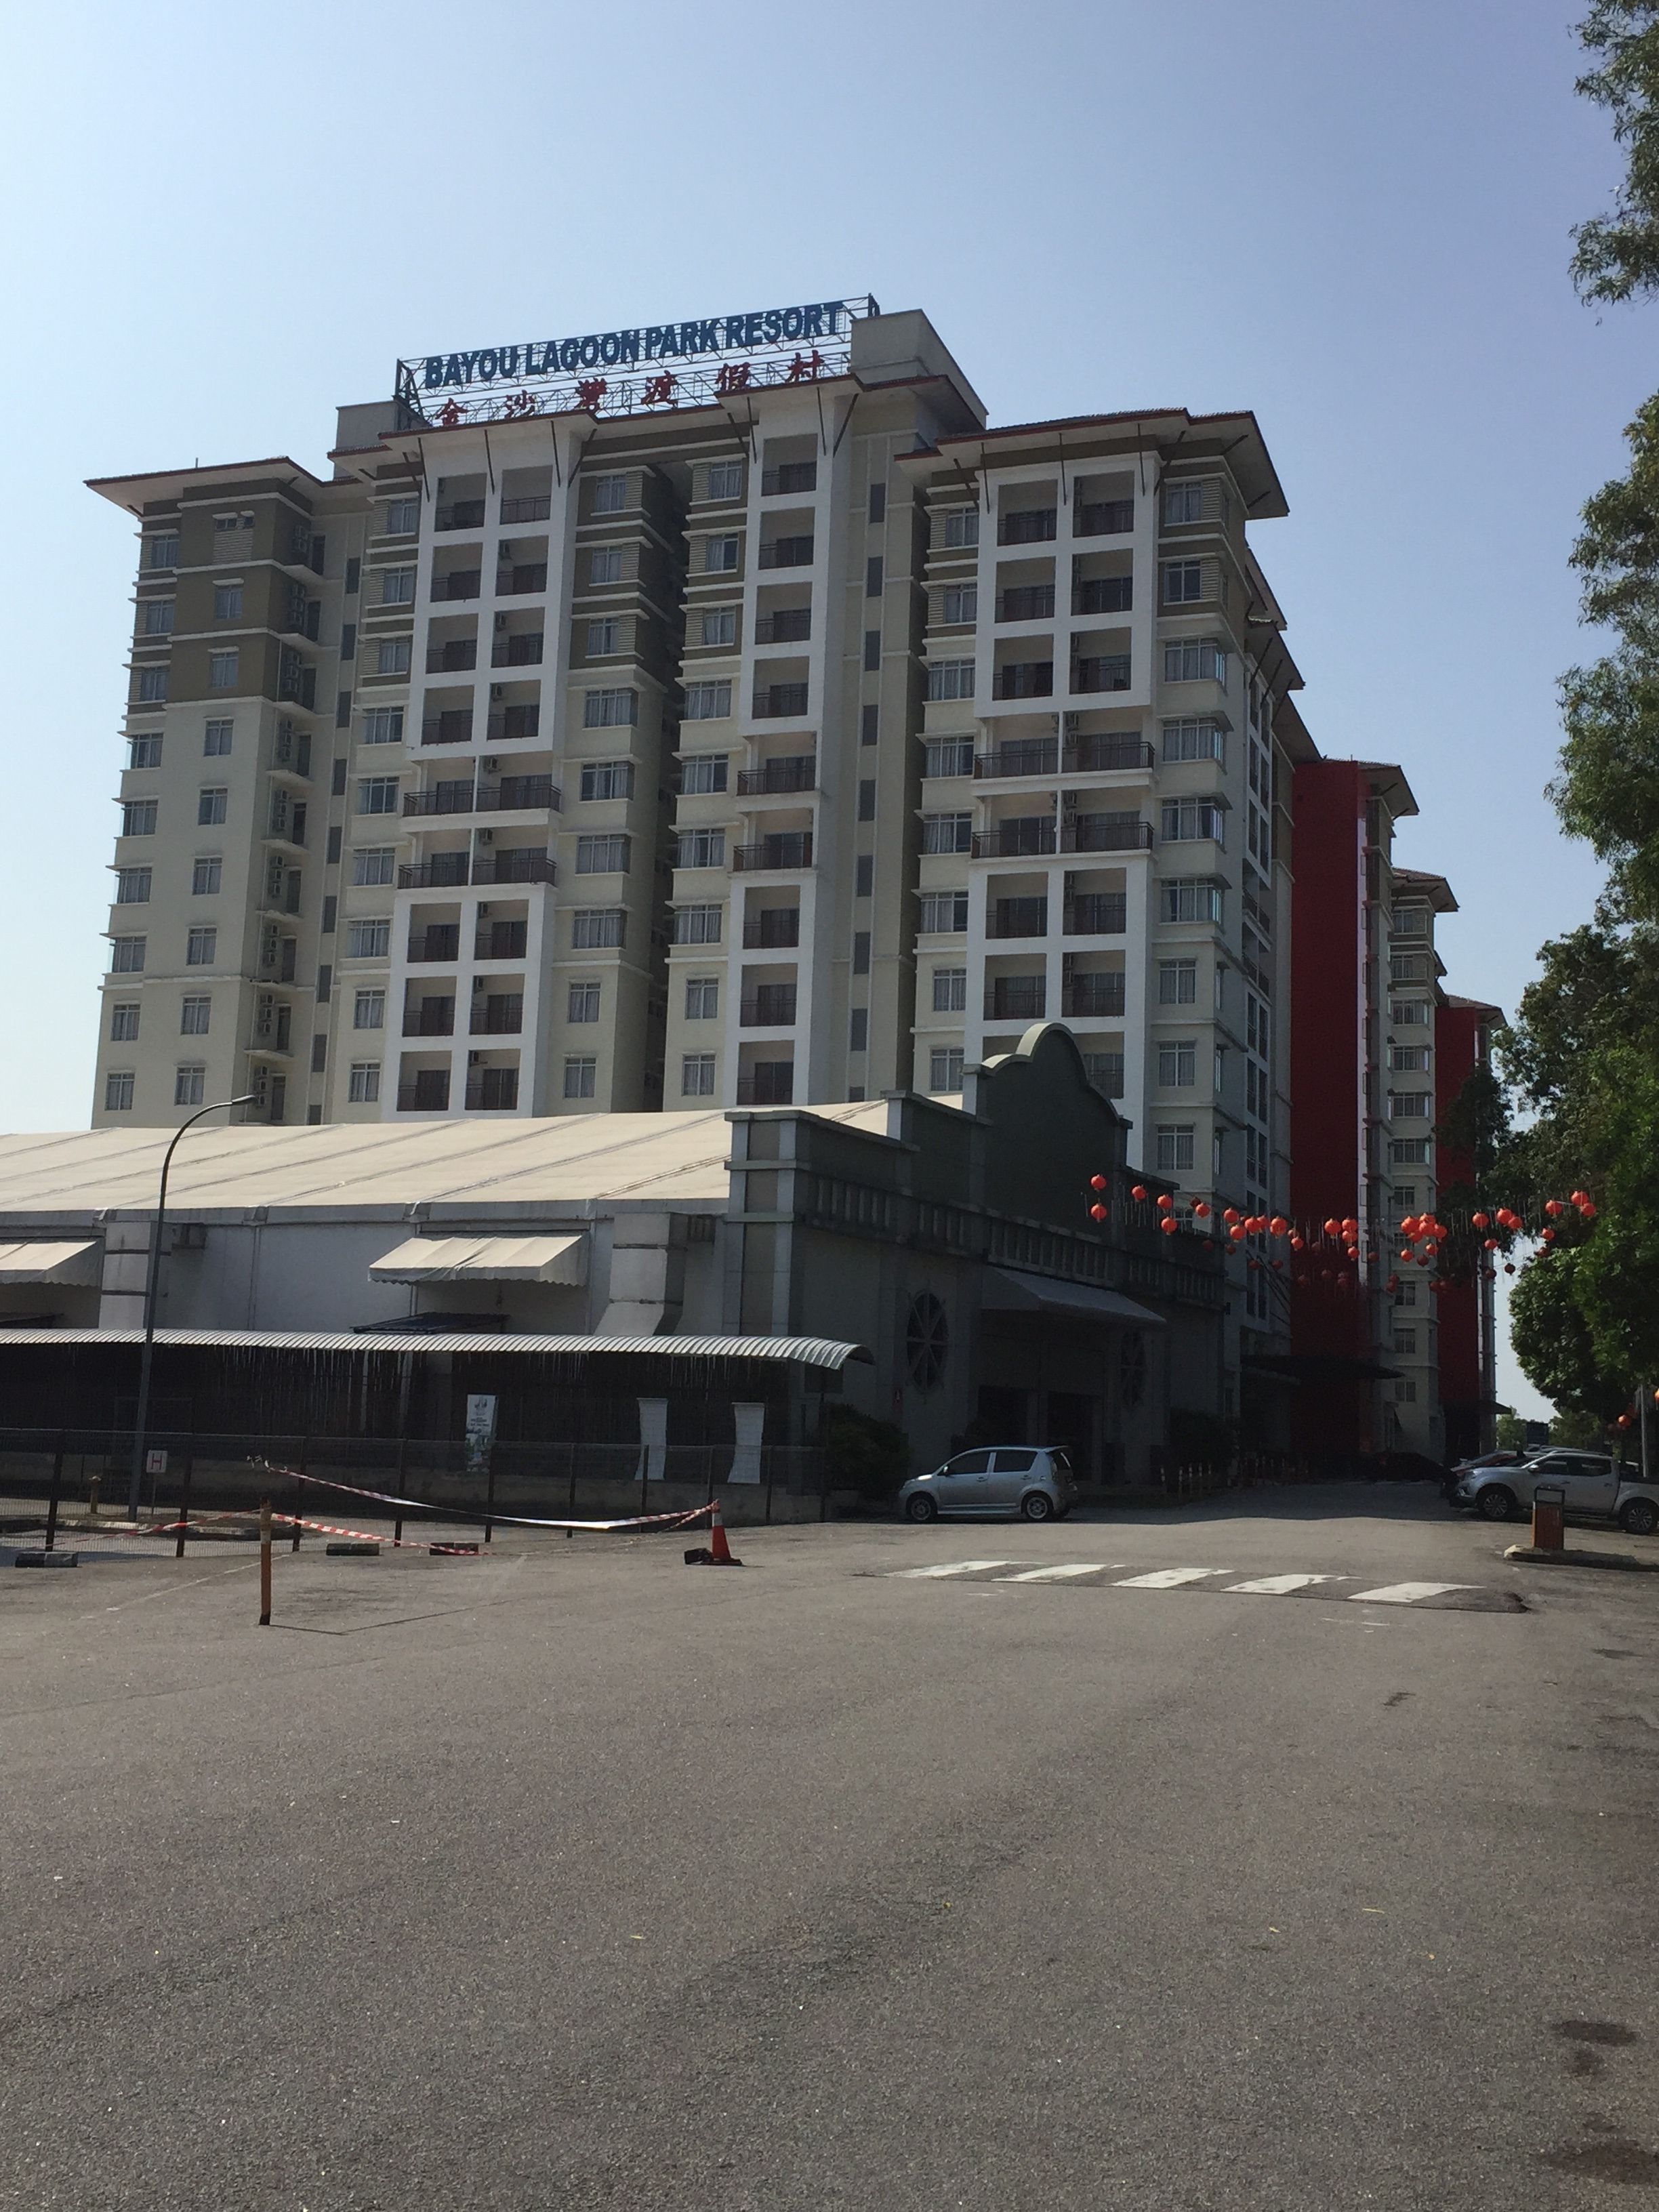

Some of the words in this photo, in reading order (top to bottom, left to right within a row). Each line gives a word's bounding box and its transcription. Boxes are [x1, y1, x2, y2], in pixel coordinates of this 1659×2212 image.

[425, 346, 520, 388] BAYOU
[525, 330, 640, 375] LAGOON
[645, 319, 721, 360] PARK
[725, 302, 844, 349] RESORT
